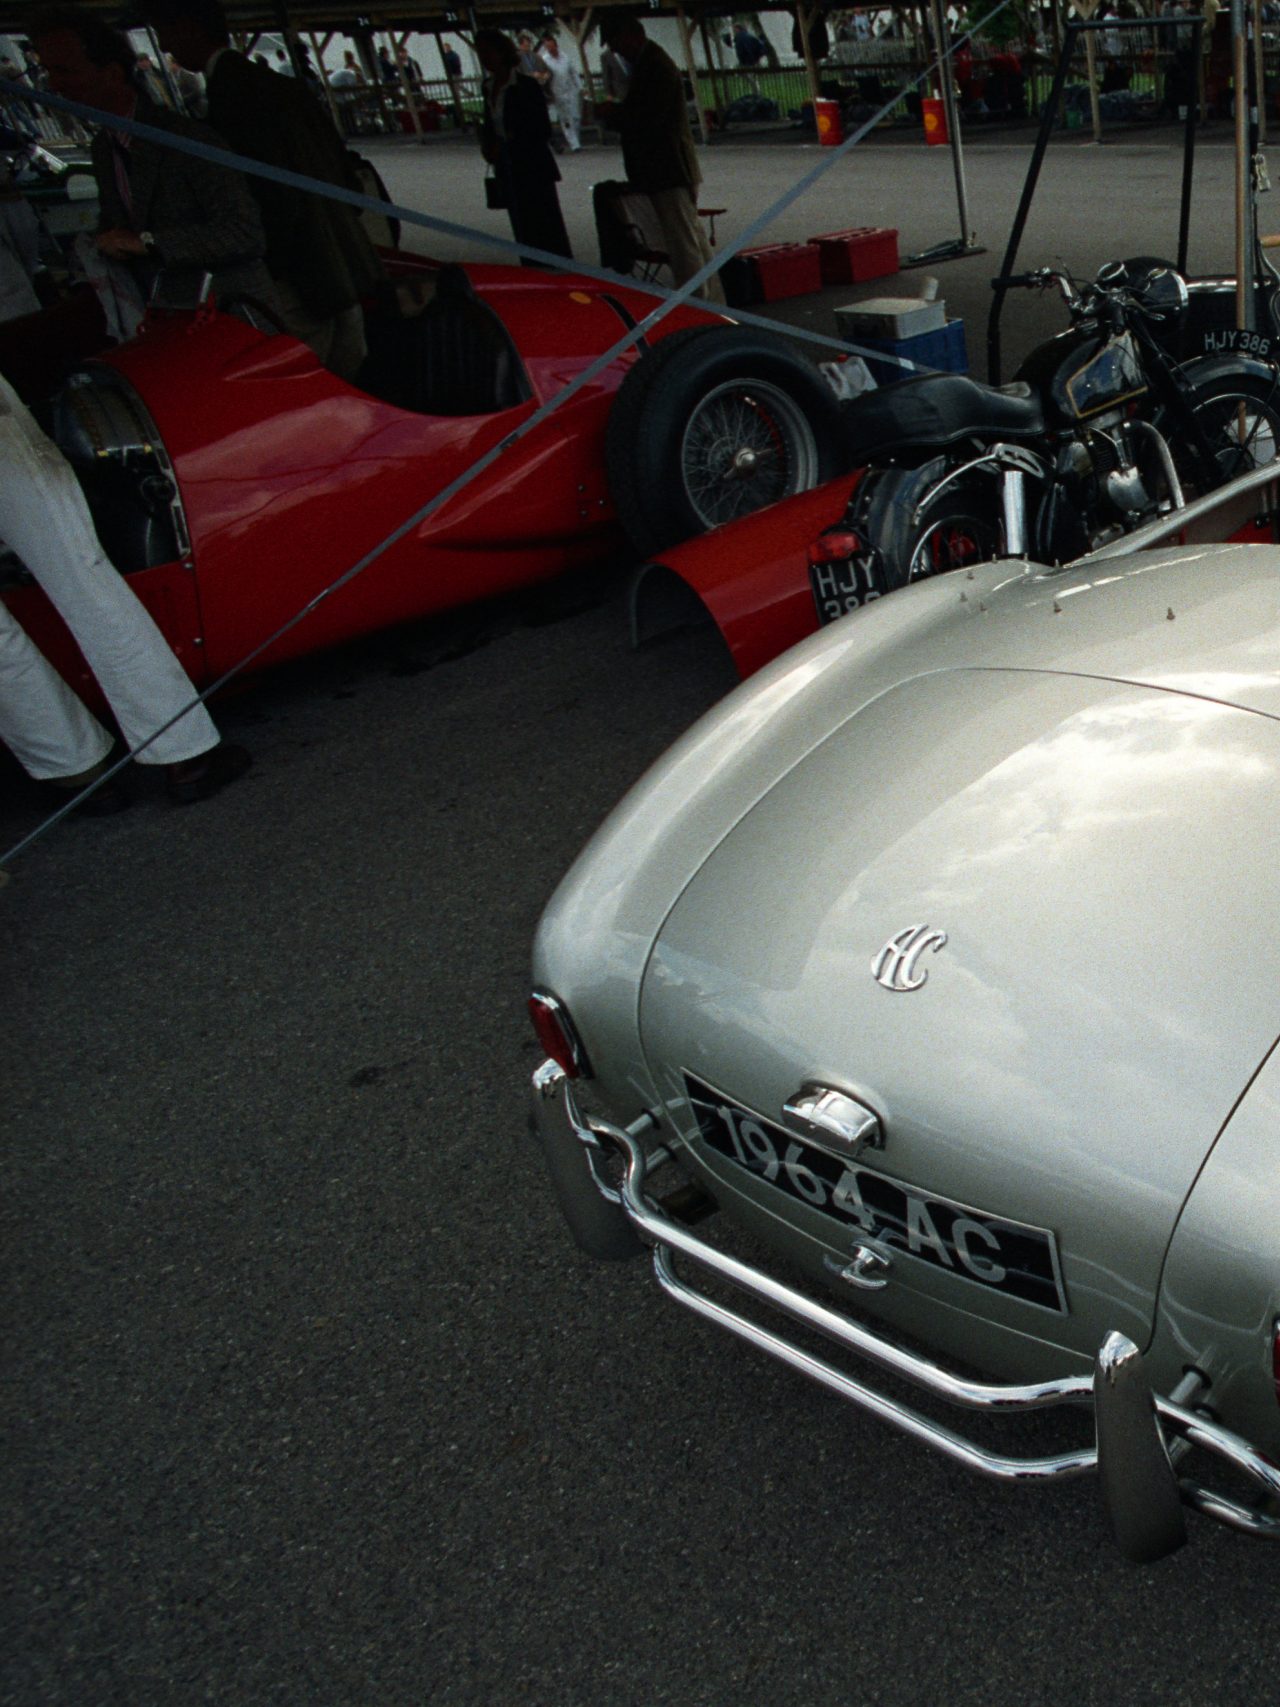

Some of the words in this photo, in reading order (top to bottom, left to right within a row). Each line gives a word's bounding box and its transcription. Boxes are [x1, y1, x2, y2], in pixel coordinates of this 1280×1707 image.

[1204, 330, 1237, 351] HJY
[1239, 332, 1271, 355] 386
[815, 555, 875, 598] HJY
[717, 1105, 876, 1231] 1964
[904, 1193, 1007, 1284] AC
